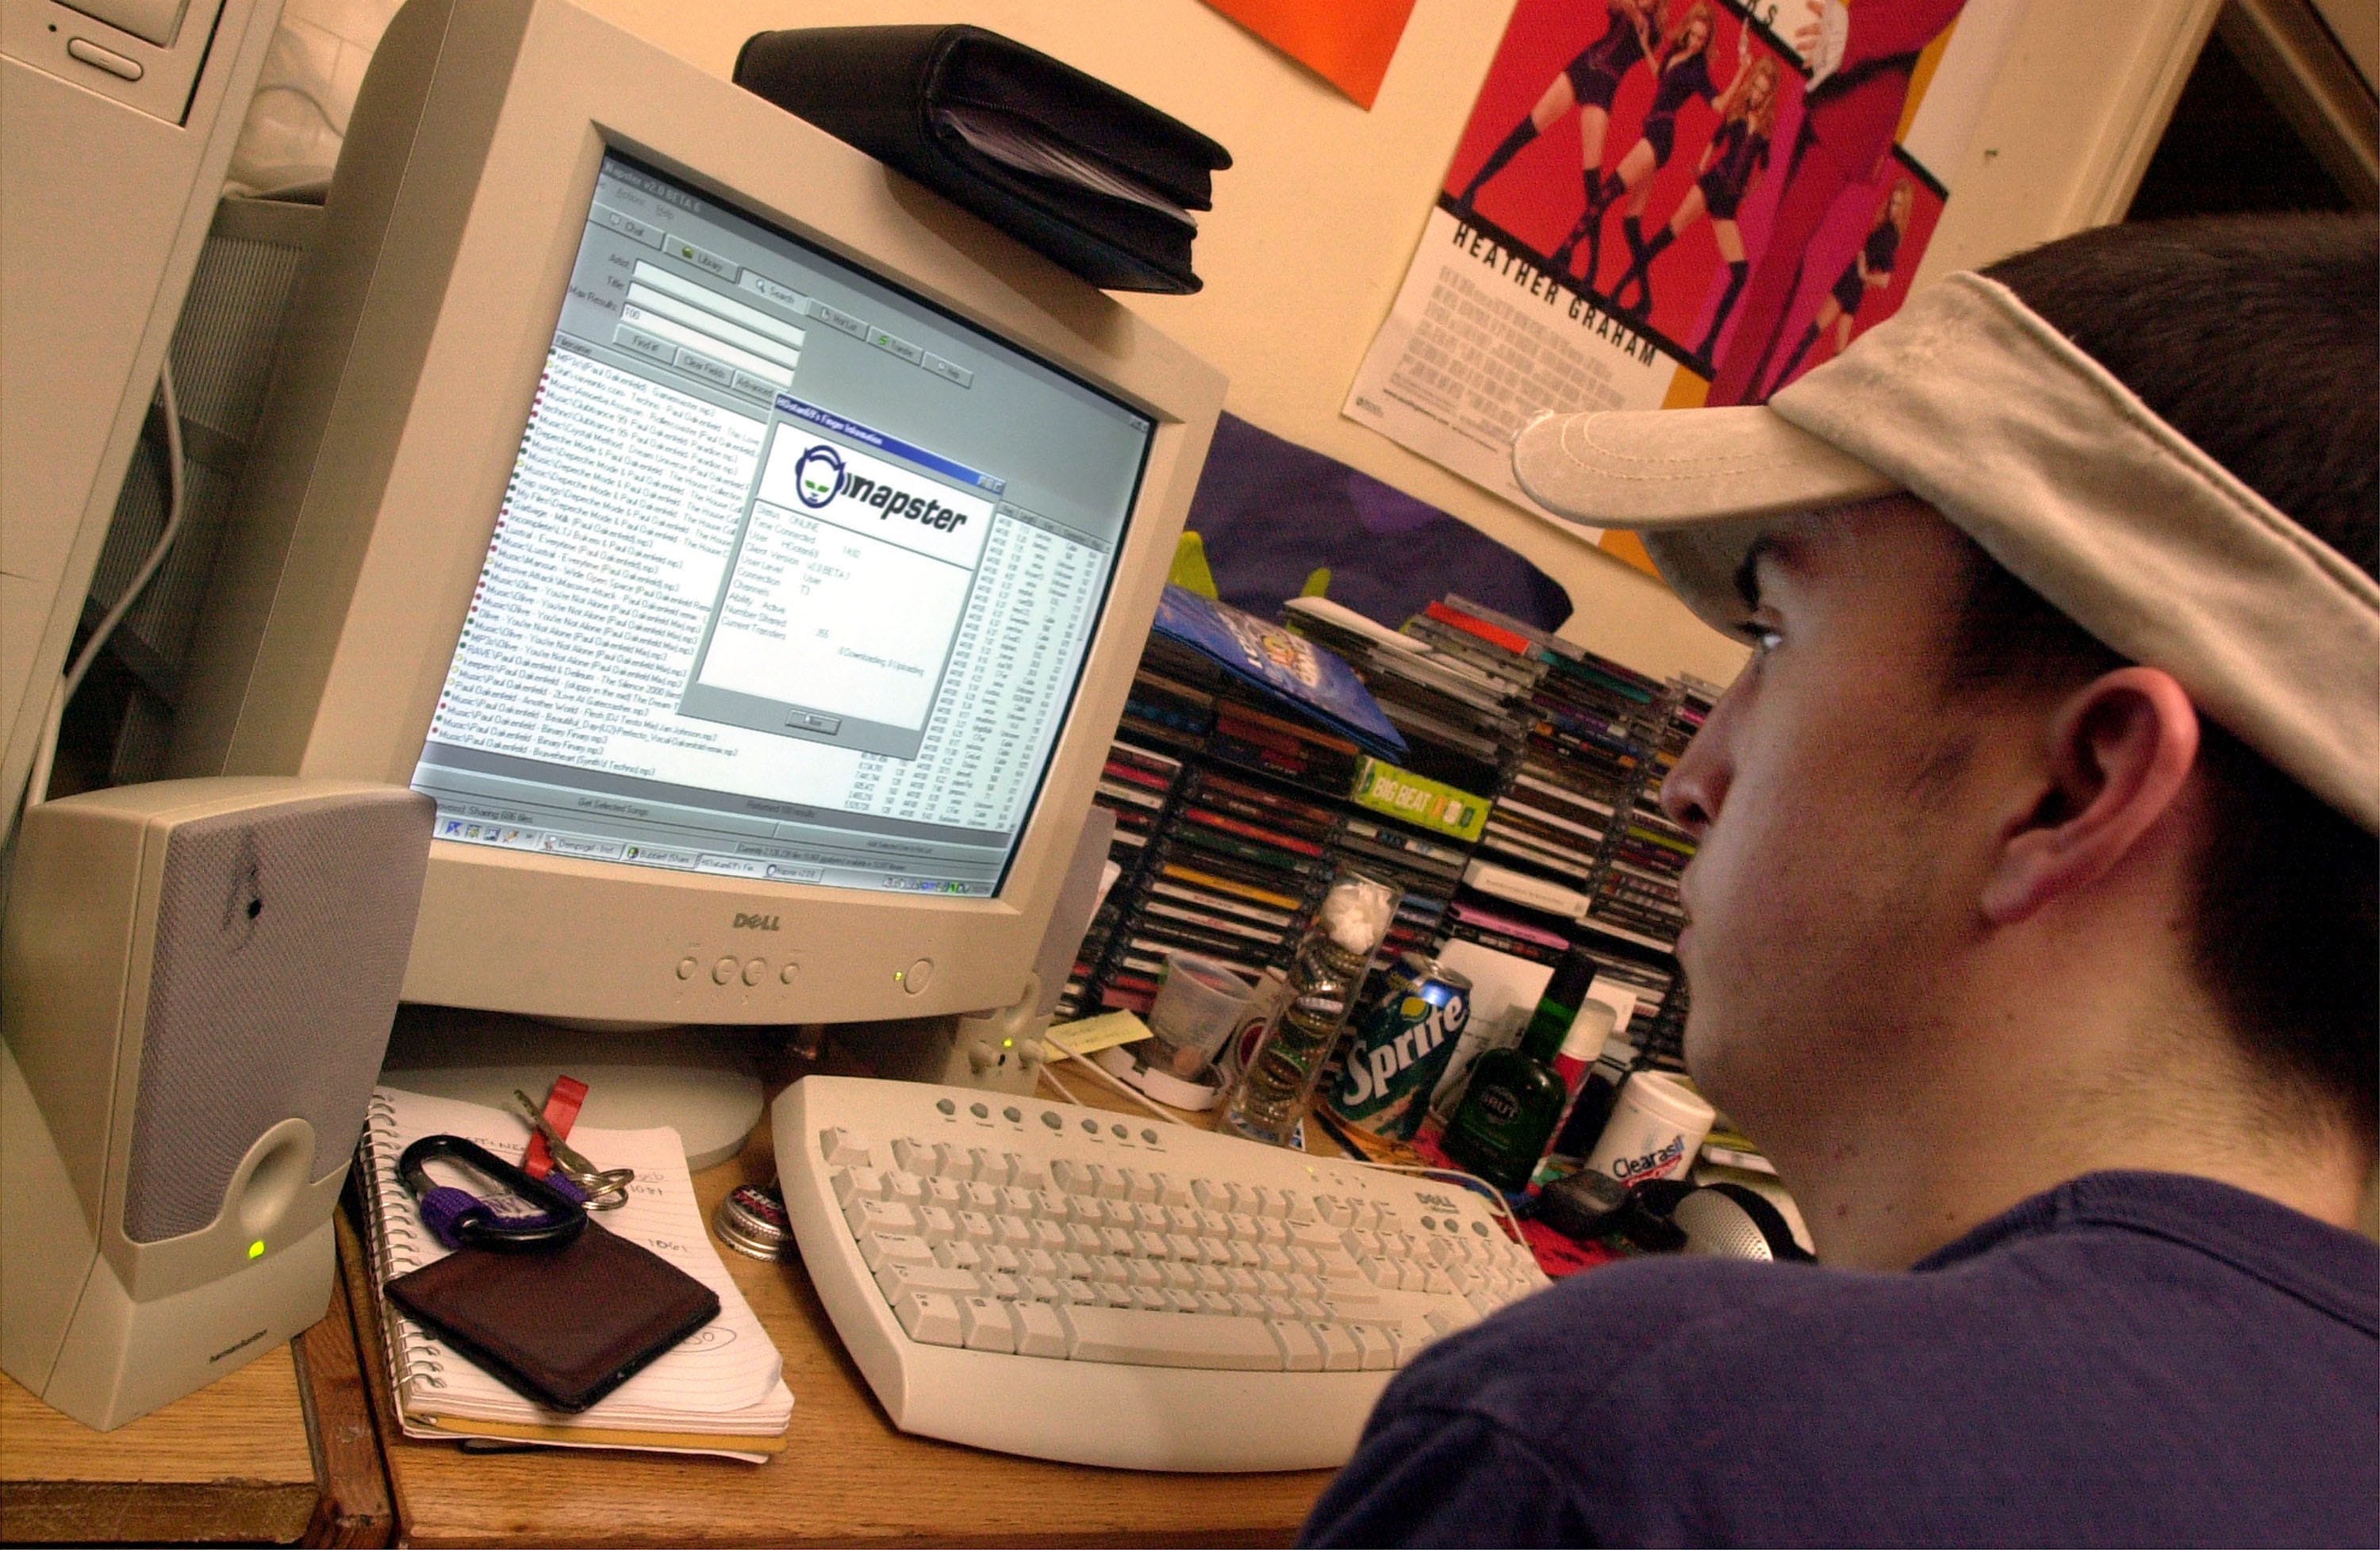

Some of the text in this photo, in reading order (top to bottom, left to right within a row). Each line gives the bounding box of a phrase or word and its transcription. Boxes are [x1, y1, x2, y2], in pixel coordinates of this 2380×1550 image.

[665, 189, 693, 209] BETA
[769, 286, 796, 305] Search
[1453, 221, 1657, 367] HEATHER GRAHAM
[846, 474, 968, 534] napster
[773, 524, 816, 544] Connected
[770, 551, 800, 566] Version
[735, 567, 781, 586] Connection
[731, 580, 770, 597] Channels
[724, 604, 756, 620] Number
[1372, 776, 1432, 813] BIG BEAT
[467, 807, 500, 819] Sharing
[593, 800, 627, 812] Selected
[627, 804, 650, 815] Songs
[733, 913, 781, 931] DELL
[1342, 996, 1468, 1106] Sprite
[1613, 1134, 1684, 1179] Clearasil
[1415, 1191, 1457, 1208] DELL
